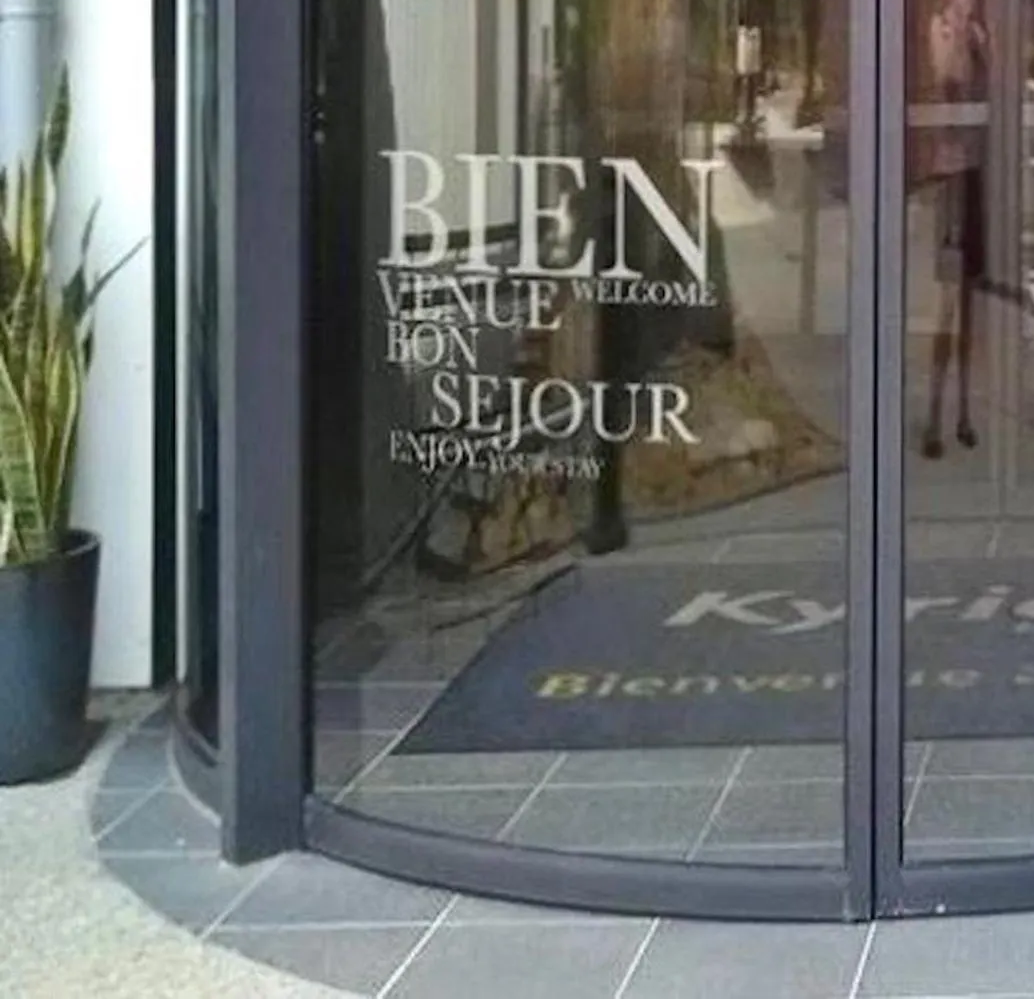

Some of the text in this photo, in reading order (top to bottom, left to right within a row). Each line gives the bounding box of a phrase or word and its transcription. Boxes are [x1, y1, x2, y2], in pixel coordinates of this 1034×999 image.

[377, 150, 725, 288] BIEN
[376, 269, 562, 330] VENUE
[387, 319, 479, 370] BON
[431, 371, 700, 452] SEJOUR
